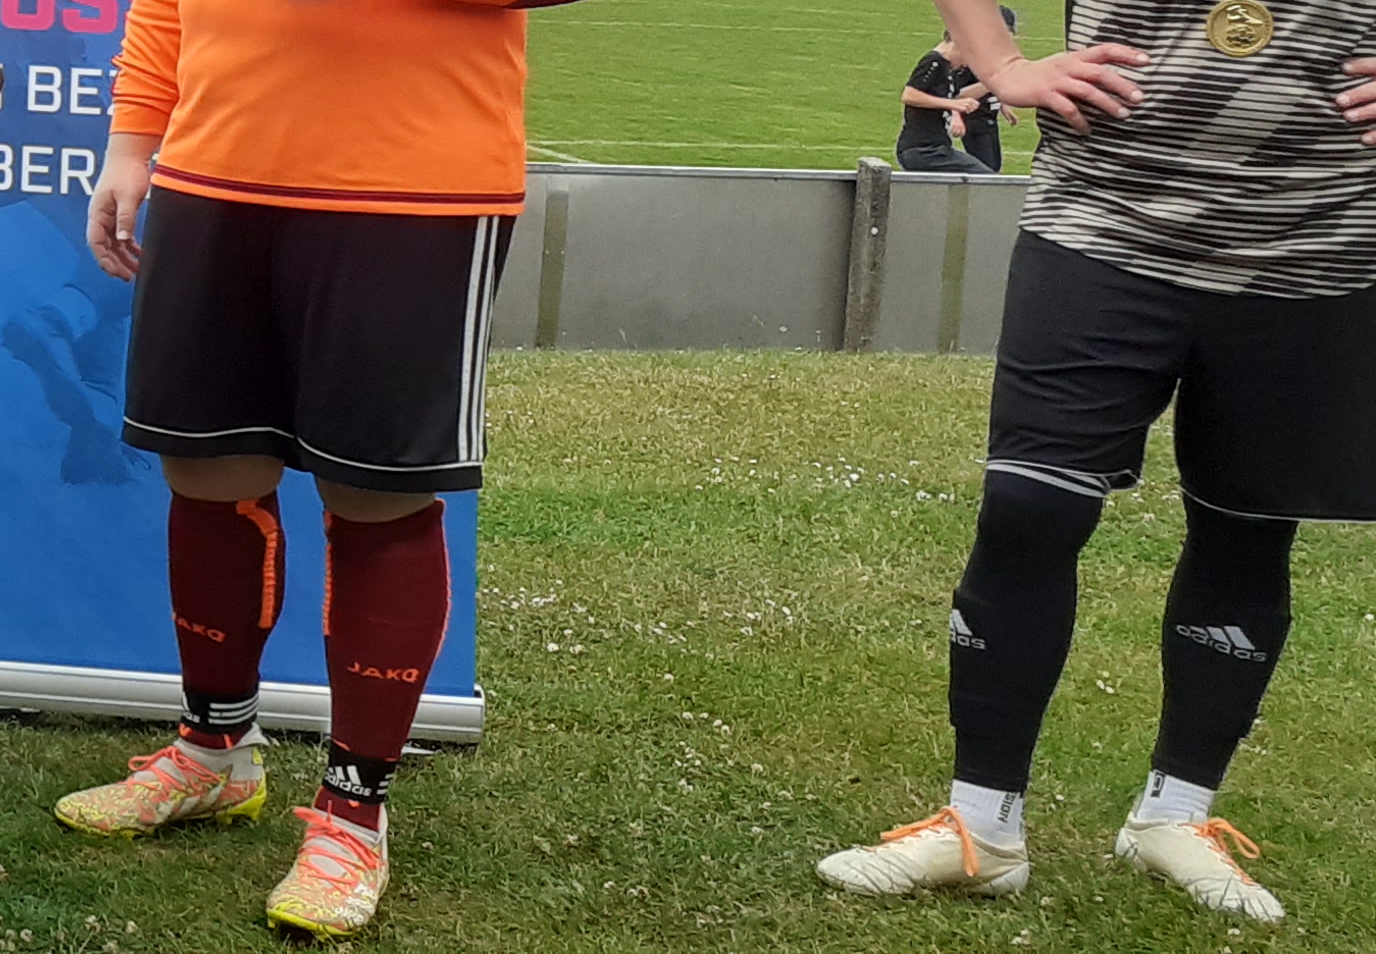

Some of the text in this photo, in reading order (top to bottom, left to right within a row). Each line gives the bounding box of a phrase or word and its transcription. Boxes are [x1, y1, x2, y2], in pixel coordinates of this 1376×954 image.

[1176, 624, 1267, 663] adidas
[347, 661, 421, 684] JAKO
[324, 771, 373, 797] adidas
